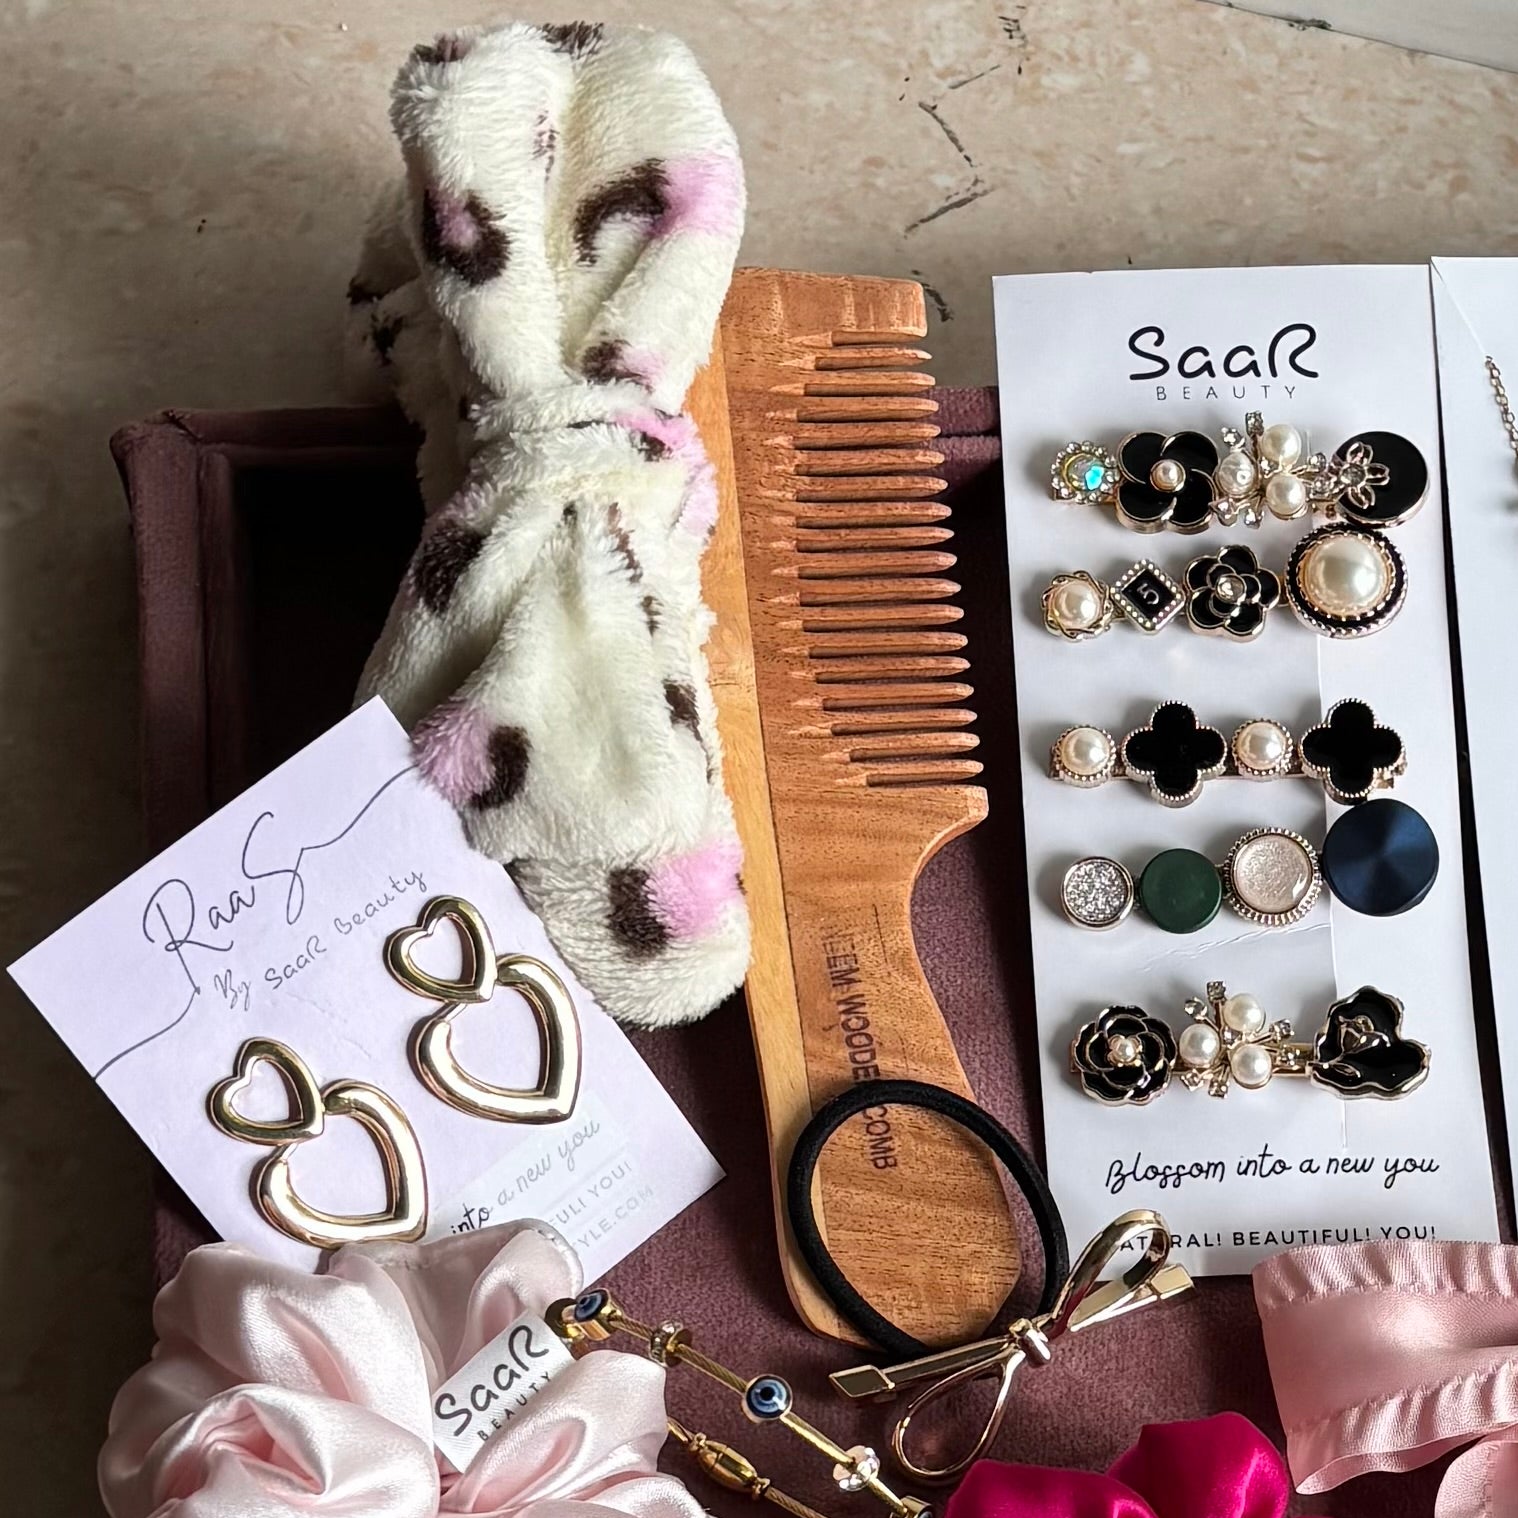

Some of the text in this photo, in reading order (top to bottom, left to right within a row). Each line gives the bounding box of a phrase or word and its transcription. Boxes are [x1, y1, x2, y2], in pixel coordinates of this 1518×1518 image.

[1128, 322, 1319, 381] SaaR
[1156, 384, 1296, 401] BEAUTY
[143, 811, 305, 996] RaaS
[214, 870, 428, 1012] By SaaR Beauty
[820, 926, 898, 1171] NEEM WOODE COMB
[497, 1189, 515, 1207] a
[515, 1153, 551, 1194] new
[557, 1119, 601, 1172] you
[1105, 1142, 1441, 1195] Blossom into a new you
[571, 1183, 655, 1249] YLE.COM
[1118, 1225, 1437, 1252] ATRAL! BEAUTIFUL! YOU!
[434, 1324, 550, 1438] SaaR
[476, 1370, 552, 1443] BEAUTY
